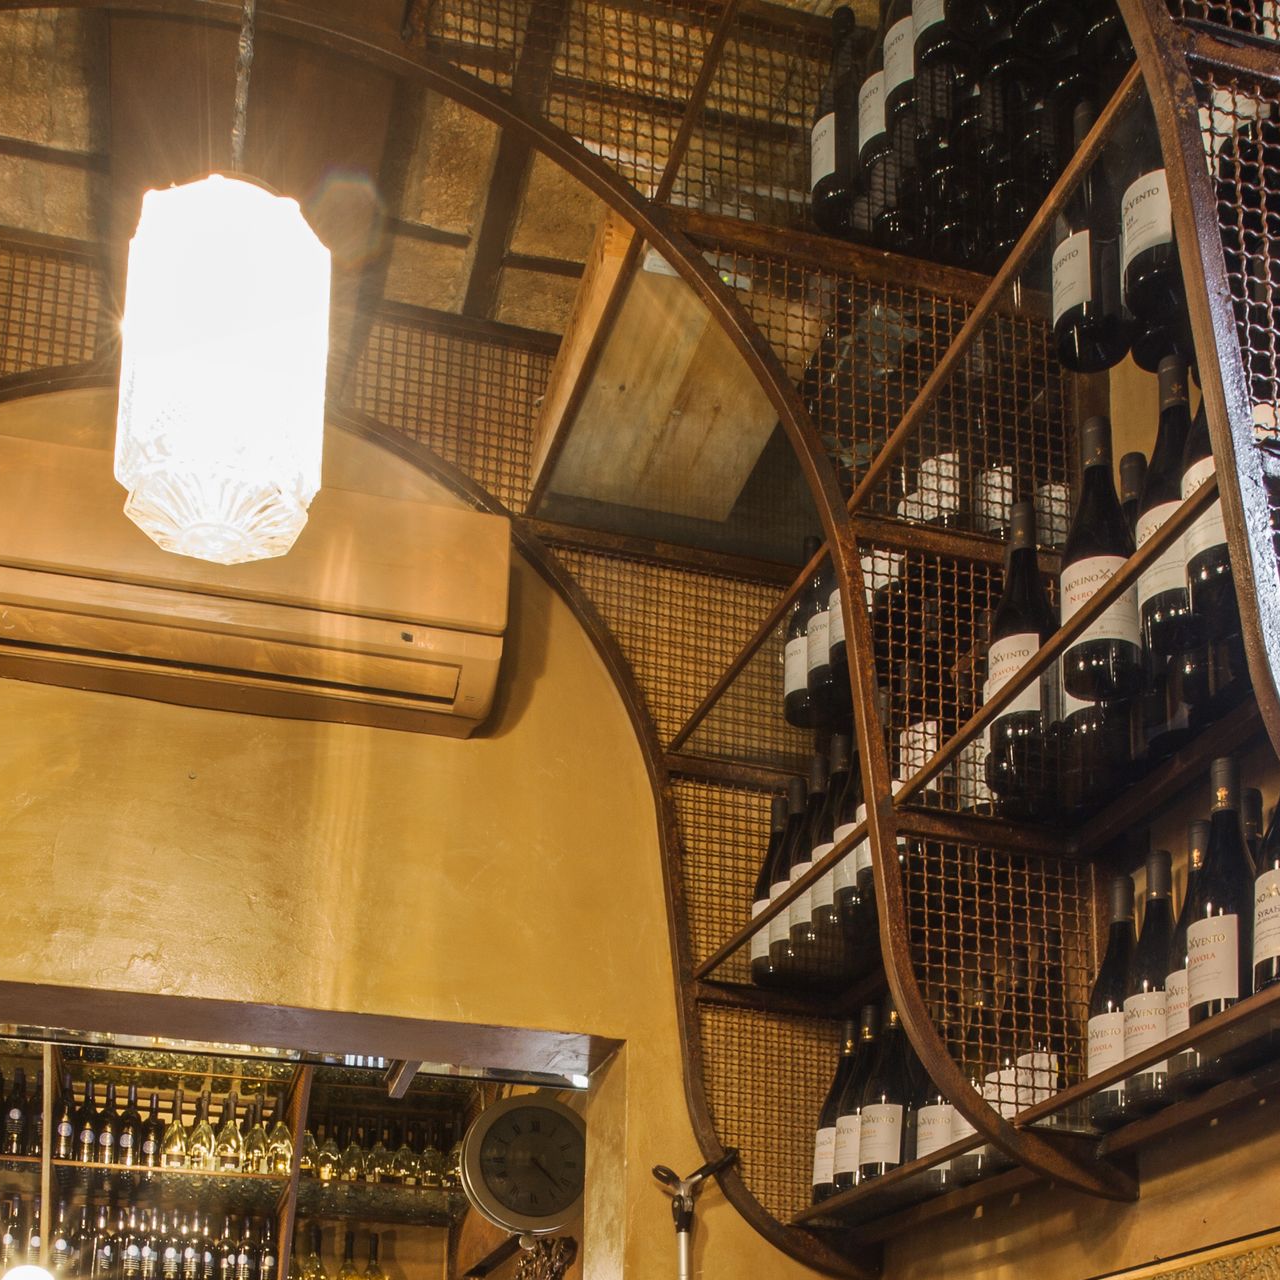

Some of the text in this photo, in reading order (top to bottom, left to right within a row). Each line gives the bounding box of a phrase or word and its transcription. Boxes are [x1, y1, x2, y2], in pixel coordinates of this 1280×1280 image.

[1064, 573, 1100, 593] MOLINO
[1069, 590, 1095, 605] NERO
[999, 649, 1031, 665] VENTO
[1256, 904, 1280, 920] SYRAH
[1194, 932, 1226, 949] VENTO
[1135, 1007, 1166, 1019] VENTO
[1094, 1027, 1121, 1040] VENTO
